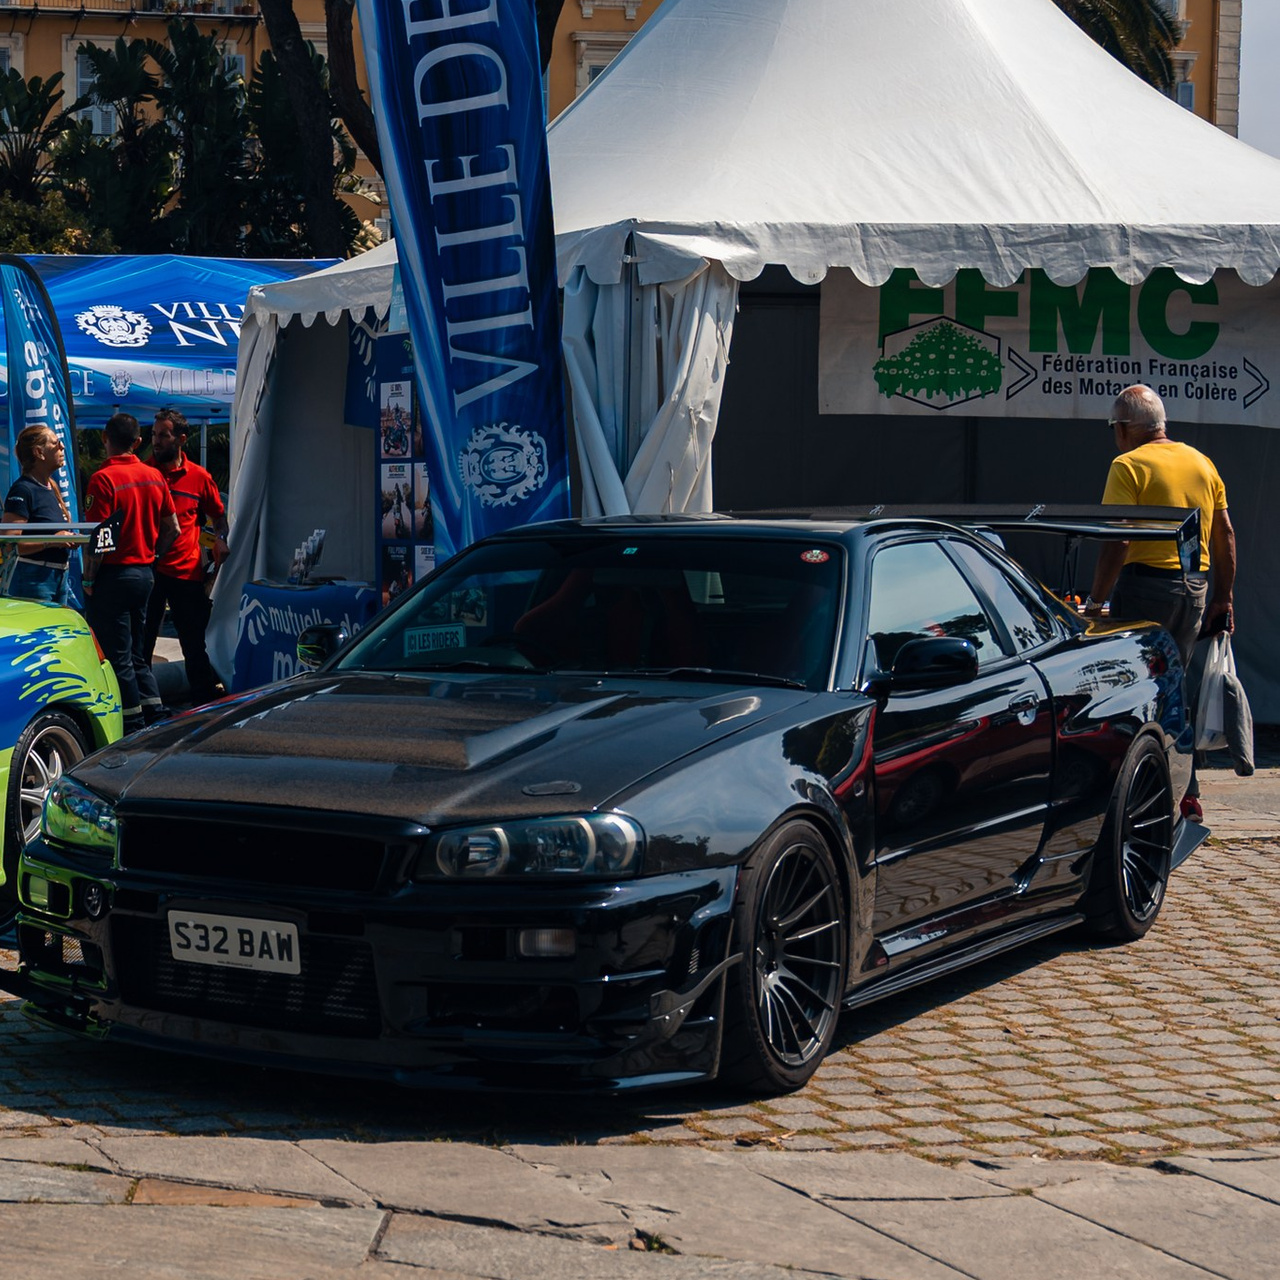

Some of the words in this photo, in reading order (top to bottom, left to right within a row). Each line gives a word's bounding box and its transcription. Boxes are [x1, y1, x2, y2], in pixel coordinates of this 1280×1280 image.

[424, 144, 539, 418] VILLE
[149, 302, 245, 321] VILL
[148, 368, 215, 396] VILLE
[1042, 354, 1142, 375] Fédération
[1148, 357, 1239, 382] Française
[1042, 378, 1072, 395] des
[1158, 385, 1179, 399] en
[1184, 380, 1238, 402] Colère
[418, 632, 431, 650] LES
[431, 630, 460, 649] RIDERS
[174, 922, 229, 955] S32
[237, 927, 293, 962] BAW
